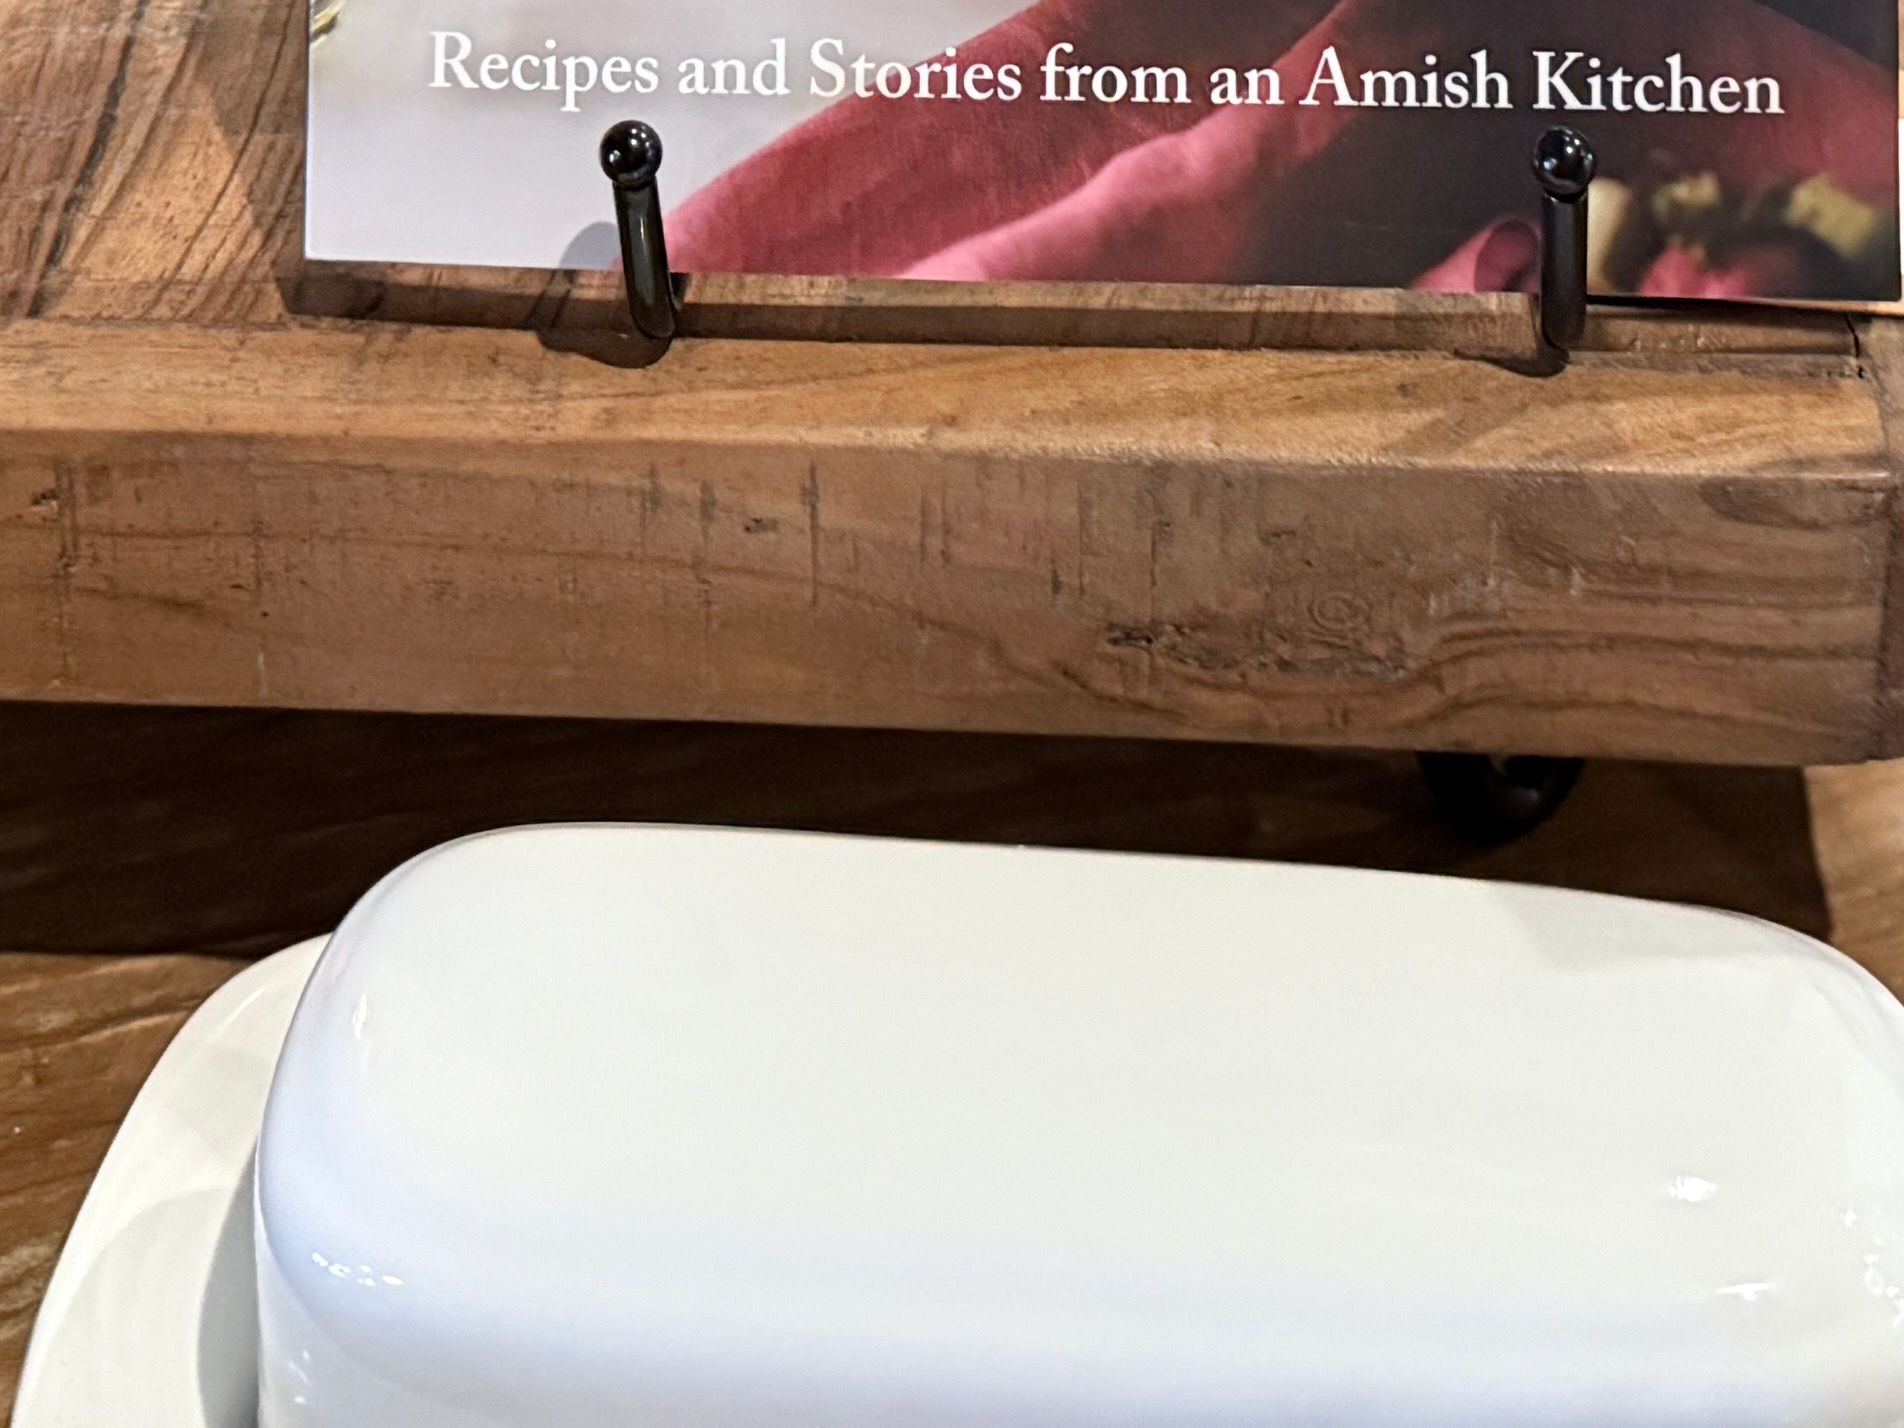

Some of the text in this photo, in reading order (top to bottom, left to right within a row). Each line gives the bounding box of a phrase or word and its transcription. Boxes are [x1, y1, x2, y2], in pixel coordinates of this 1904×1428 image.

[429, 31, 1785, 114] Recipes and Stories from an Amish Kitchen
